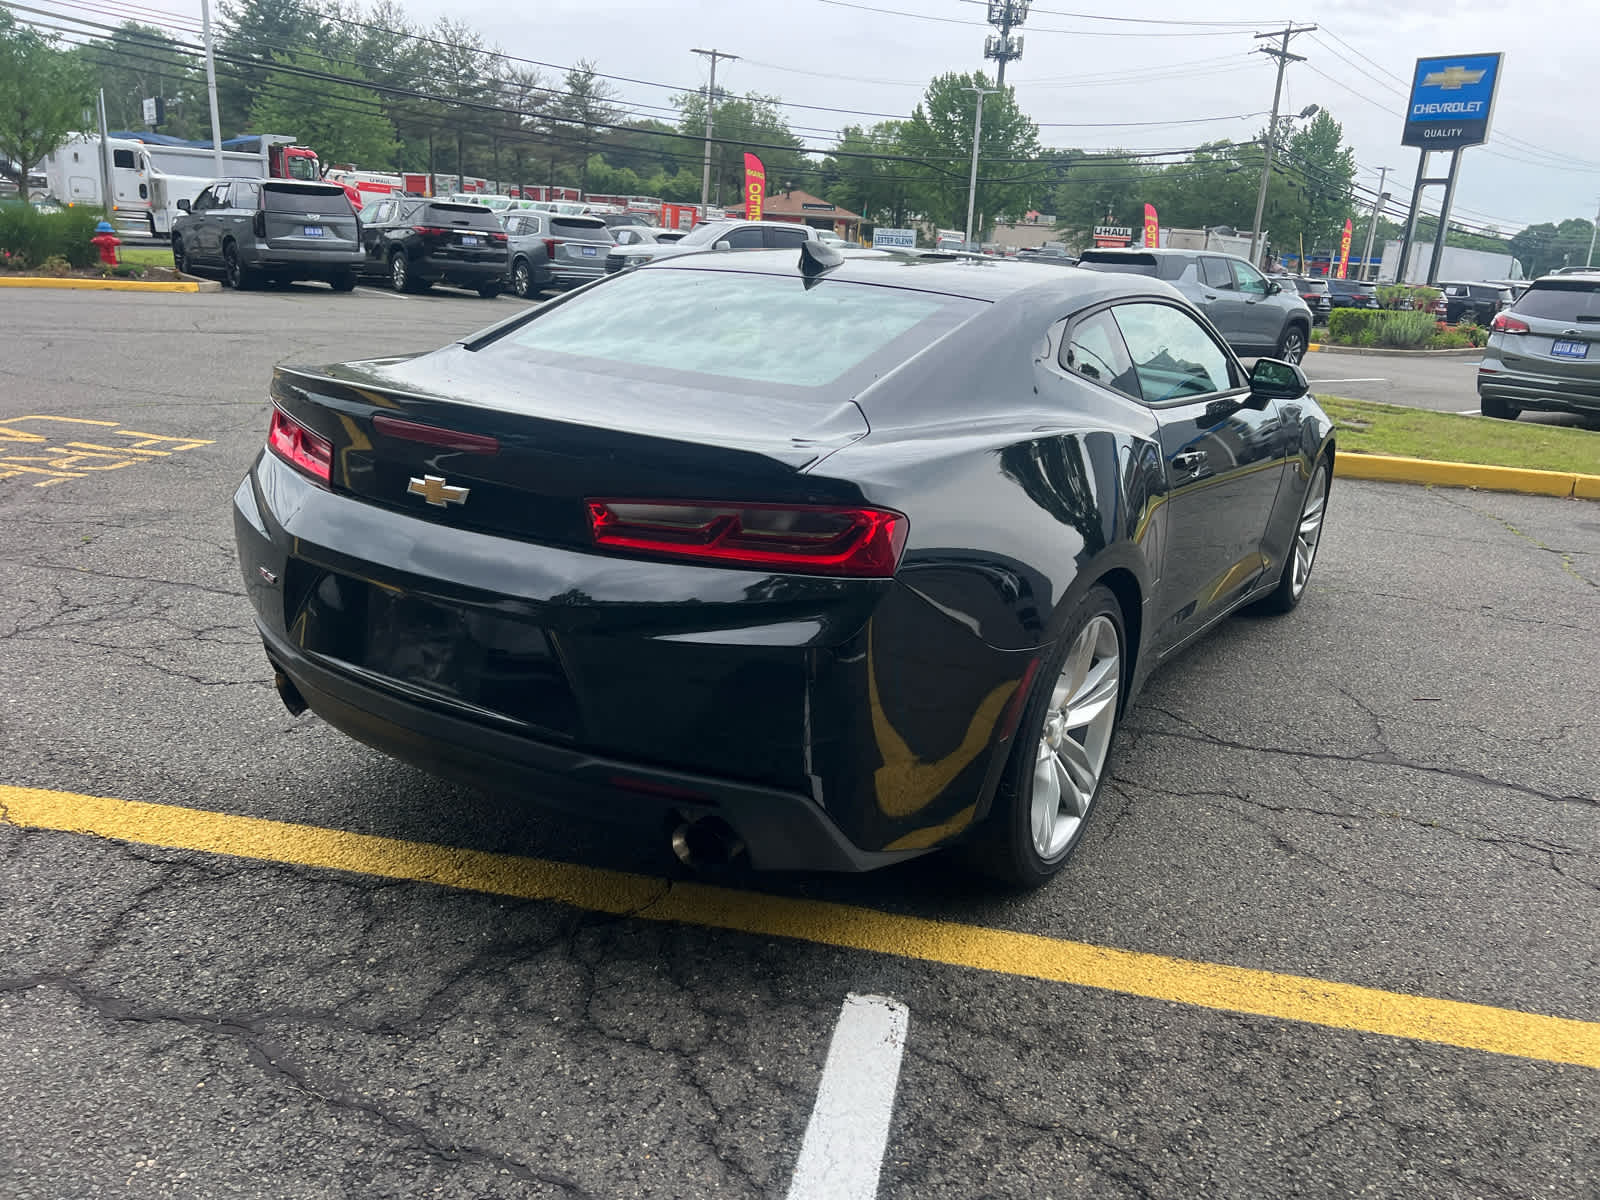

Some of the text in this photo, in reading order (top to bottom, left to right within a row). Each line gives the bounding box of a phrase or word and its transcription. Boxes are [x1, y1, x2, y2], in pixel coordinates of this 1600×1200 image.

[1413, 101, 1484, 114] CHEVROLET
[1423, 128, 1463, 138] QUALITY
[1094, 228, 1130, 236] U-HAUL
